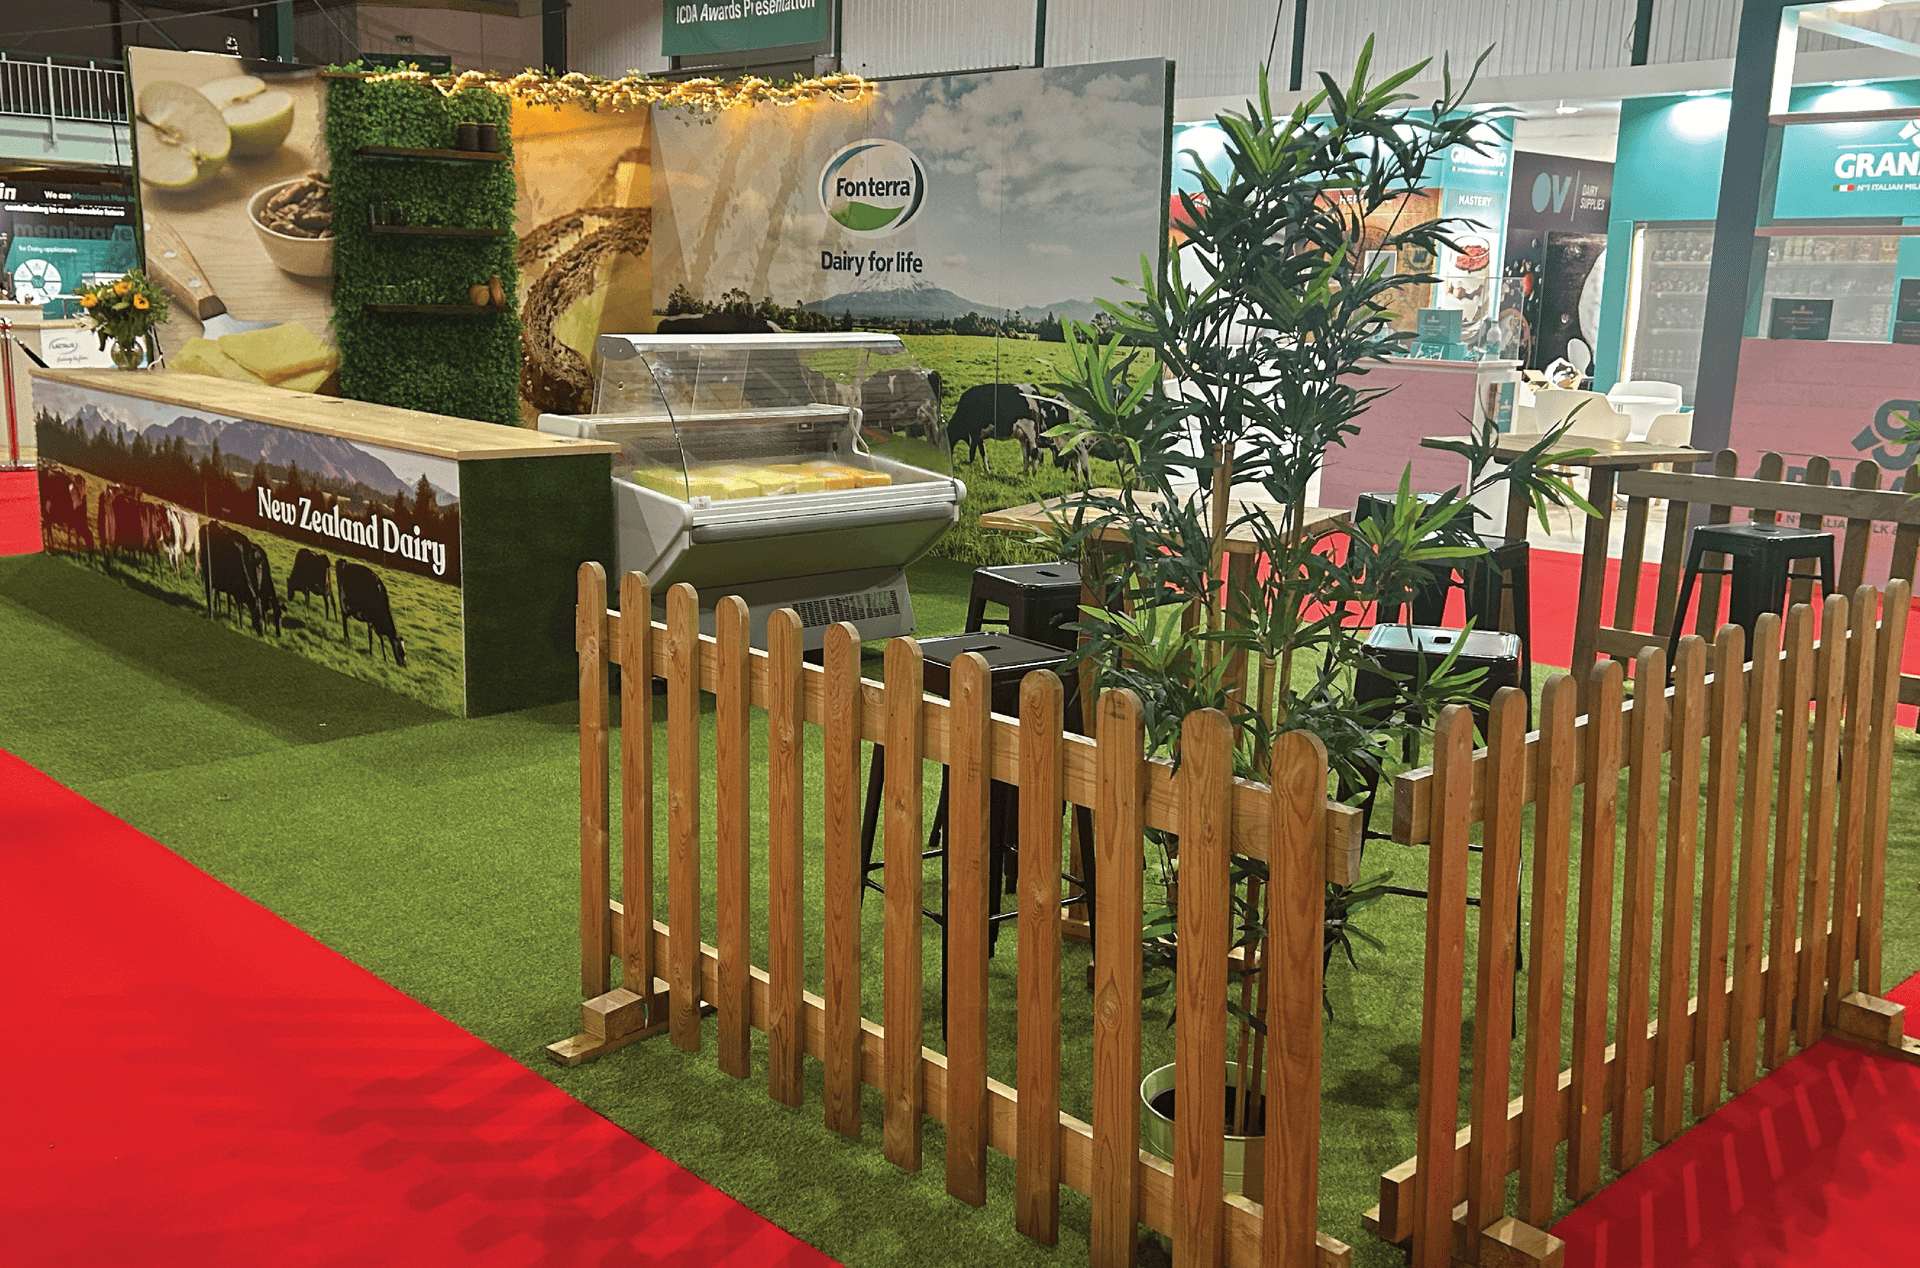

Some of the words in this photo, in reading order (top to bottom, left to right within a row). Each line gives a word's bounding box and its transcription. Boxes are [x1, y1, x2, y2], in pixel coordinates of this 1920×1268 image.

[676, 4, 698, 24] ICDA
[700, 0, 742, 22] Awards
[744, 0, 816, 18] Presentation
[1834, 151, 1920, 179] GRAN
[44, 190, 58, 199] We
[836, 177, 911, 197] Fonterra
[1532, 172, 1573, 214] OV
[1582, 184, 1599, 197] DAIRY
[1871, 183, 1904, 191] ITALIAN
[1458, 194, 1492, 207] MASTERY
[1580, 197, 1606, 211] SUPPLIES
[821, 250, 865, 277] Dairy
[868, 250, 894, 272] for
[896, 251, 923, 273] life
[257, 486, 297, 526] New
[298, 497, 380, 549] Zealand
[382, 518, 446, 576] Dairy
